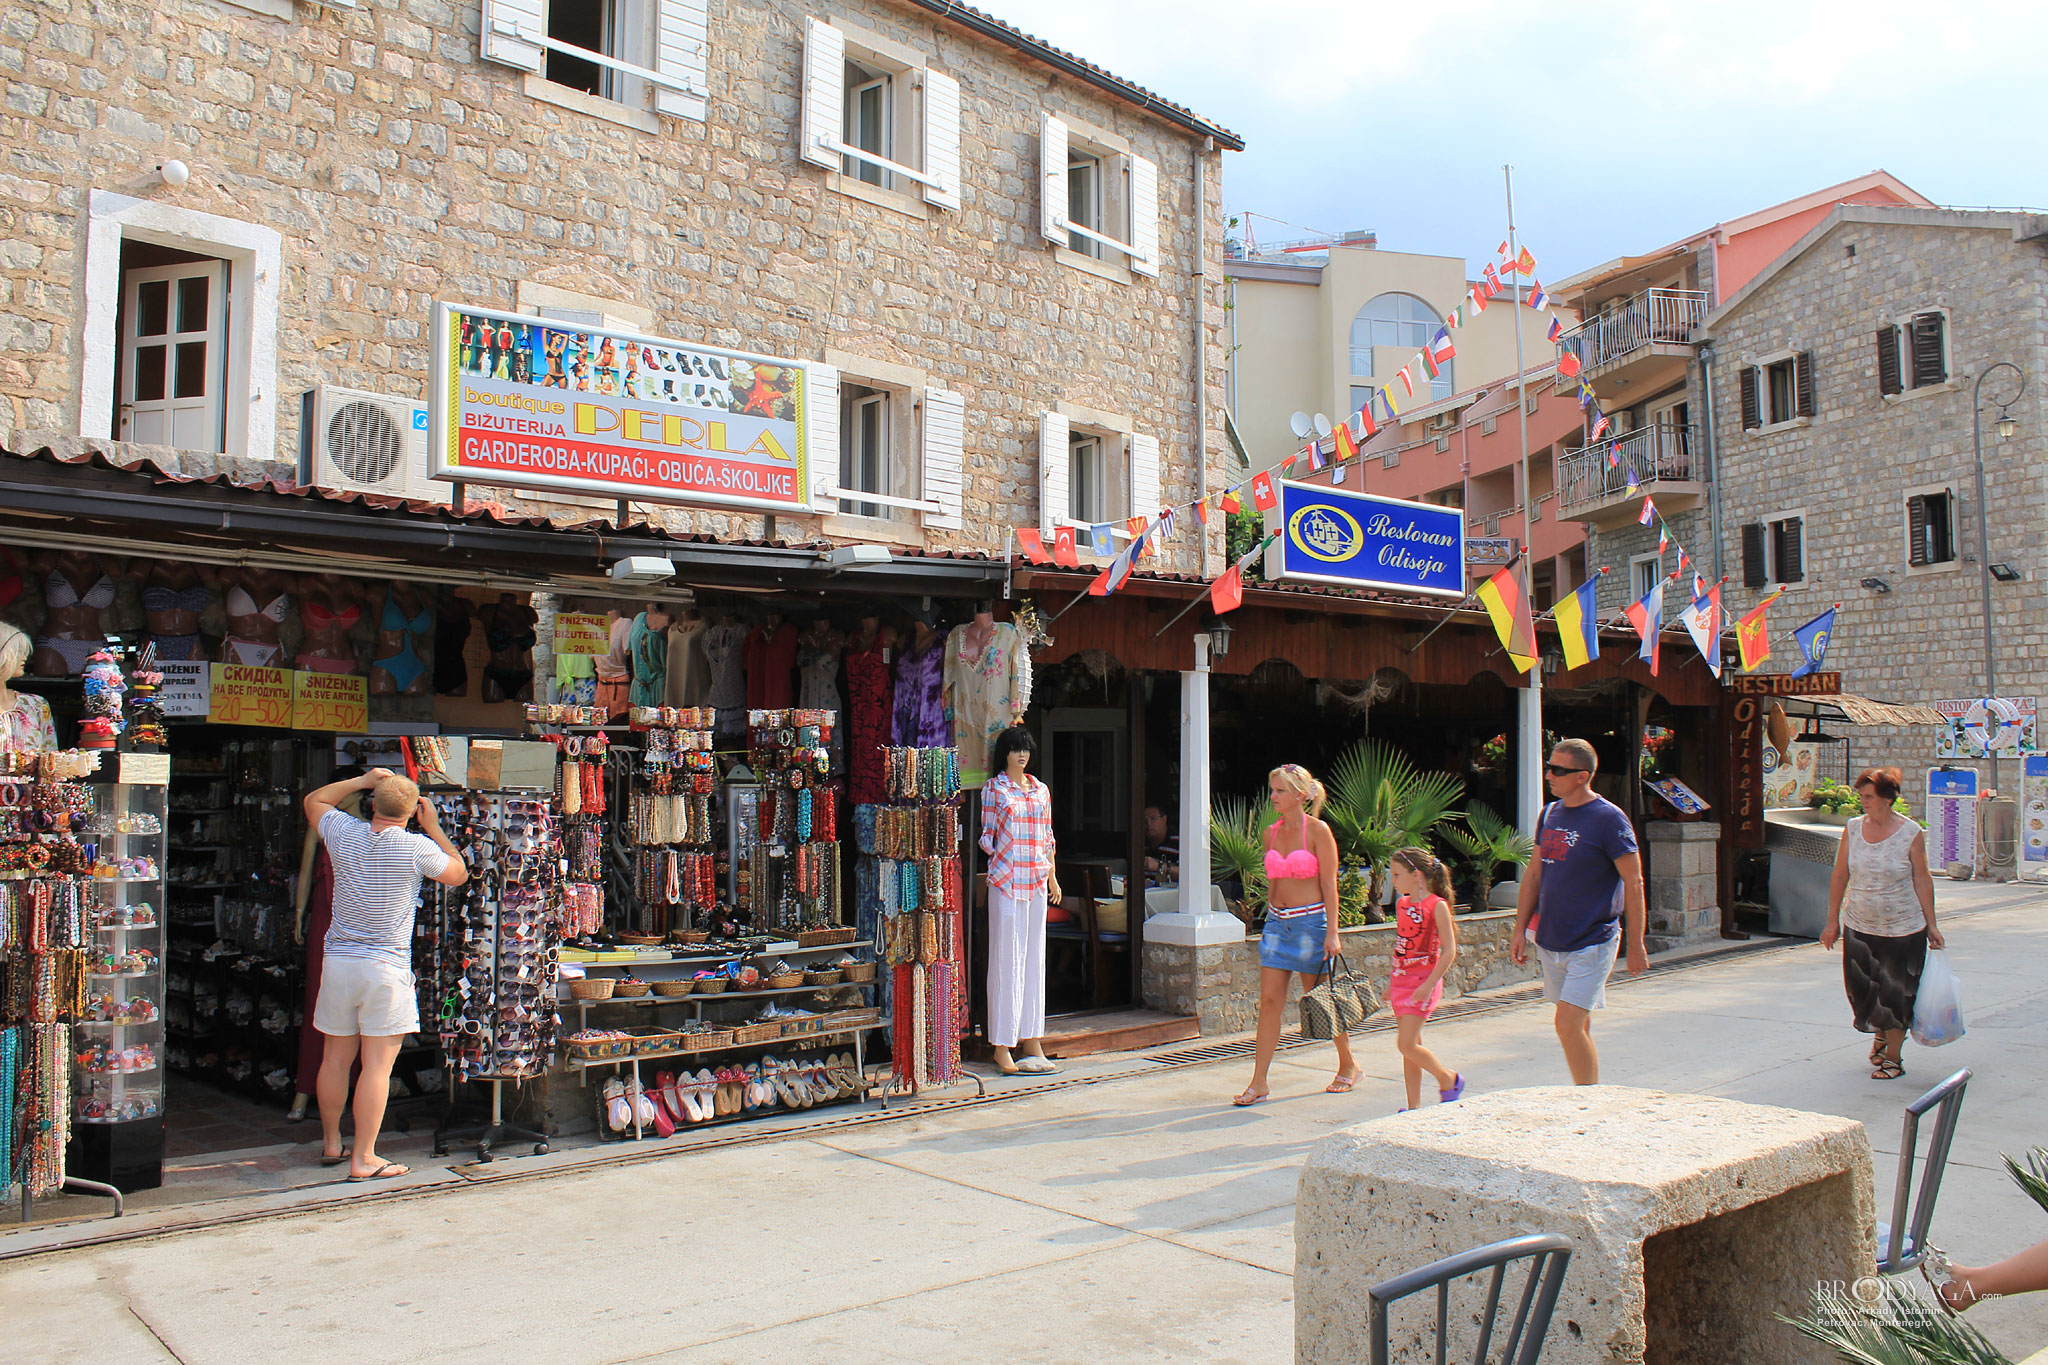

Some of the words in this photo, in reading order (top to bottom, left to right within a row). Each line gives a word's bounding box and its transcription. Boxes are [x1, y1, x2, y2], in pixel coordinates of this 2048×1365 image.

[465, 386, 566, 415] boutique
[465, 412, 567, 437] BIŽUTERIJA
[574, 402, 792, 461] PERLA
[1366, 513, 1456, 548] Restoran
[1378, 544, 1447, 580] Odiseja
[559, 616, 605, 626] SNIŽENJE
[555, 629, 609, 641] BIŽUTERIJE
[574, 645, 584, 653] 20
[224, 666, 282, 685] СКИДКА
[306, 675, 360, 691] SNIŽENJE
[1731, 674, 1836, 694] RESTORAN
[214, 684, 226, 695] НА
[228, 685, 244, 695] ВСЕ
[246, 686, 290, 699] ПРОДУКТЫ
[300, 690, 312, 699] NA
[314, 690, 330, 700] SVE
[333, 692, 364, 702] ARTIKLE
